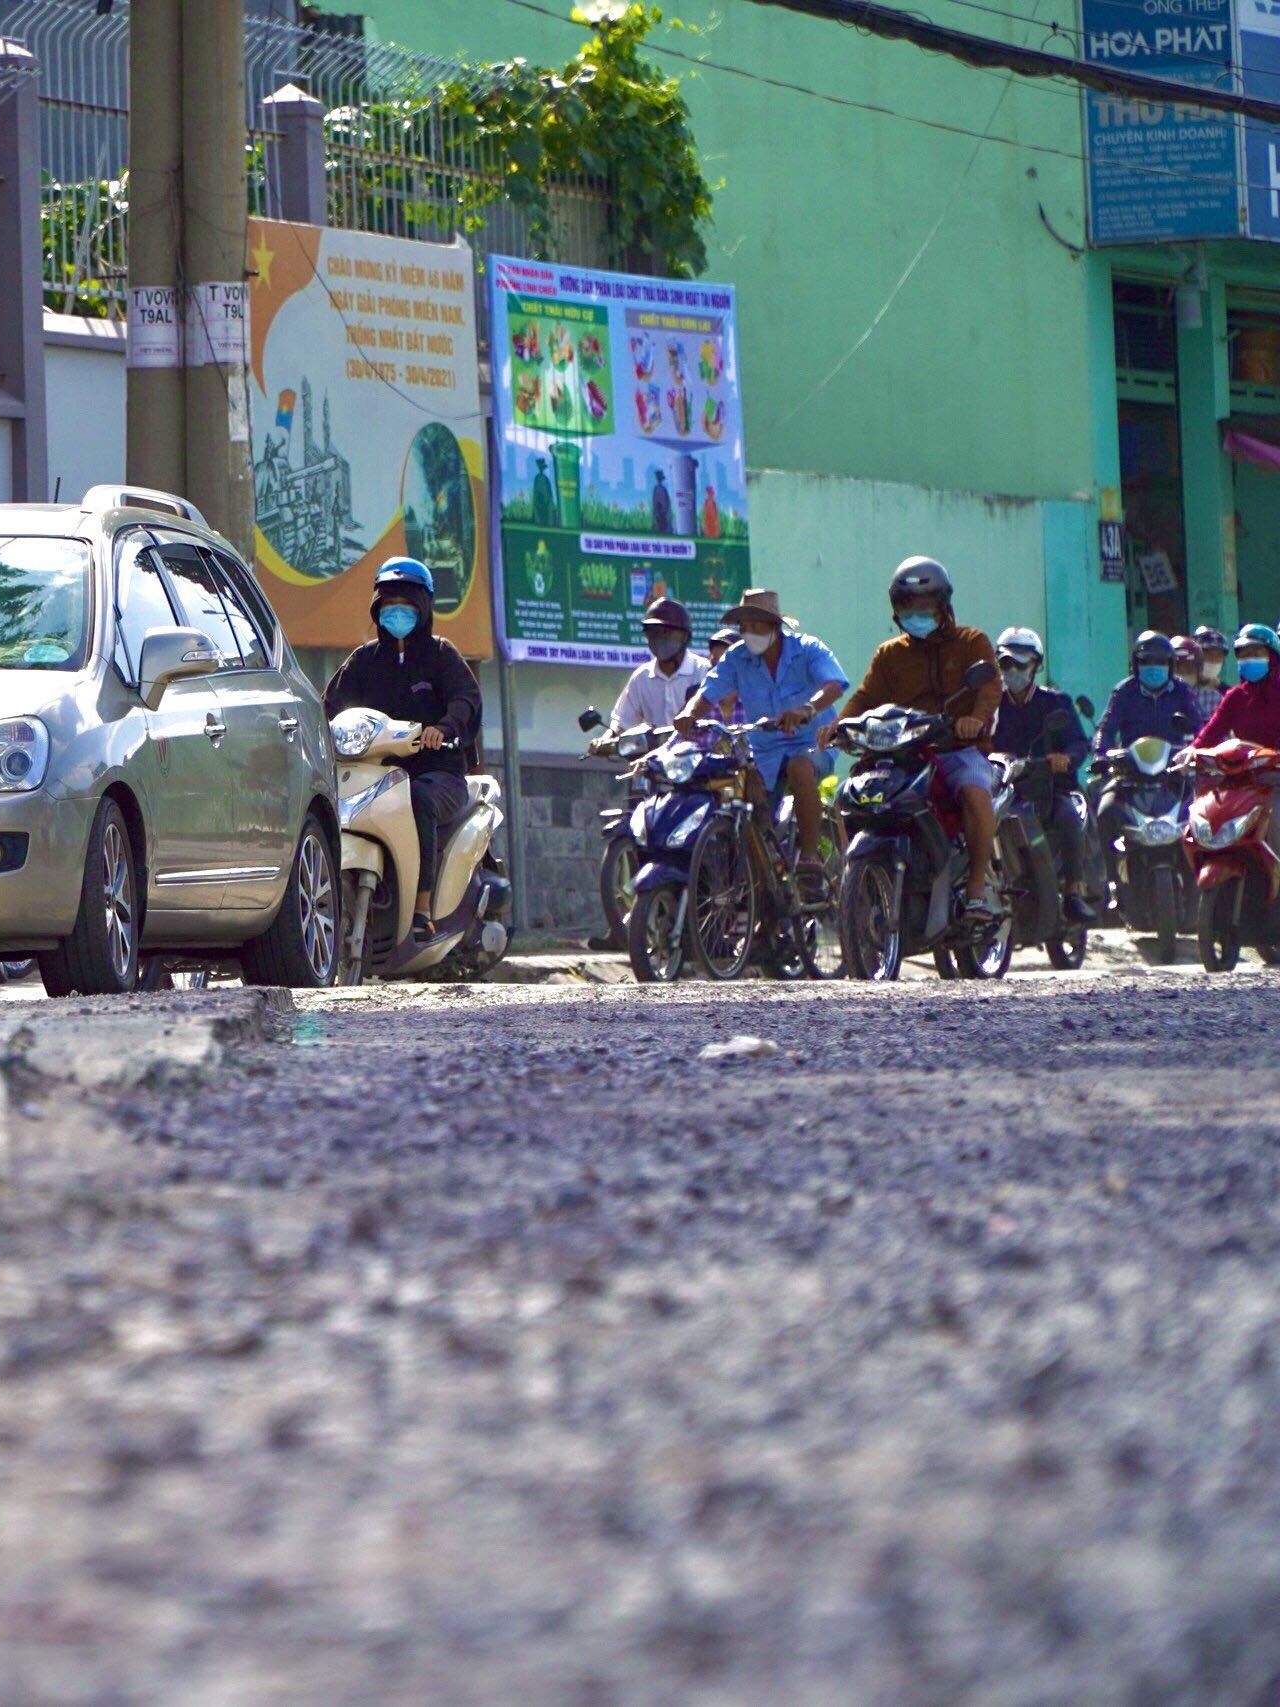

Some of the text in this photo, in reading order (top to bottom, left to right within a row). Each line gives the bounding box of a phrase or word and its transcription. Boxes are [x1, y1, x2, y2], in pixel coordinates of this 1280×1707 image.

[1093, 128, 1143, 146] CHUYÊN
[1146, 130, 1176, 142] KINH
[141, 309, 173, 324] T9AL
